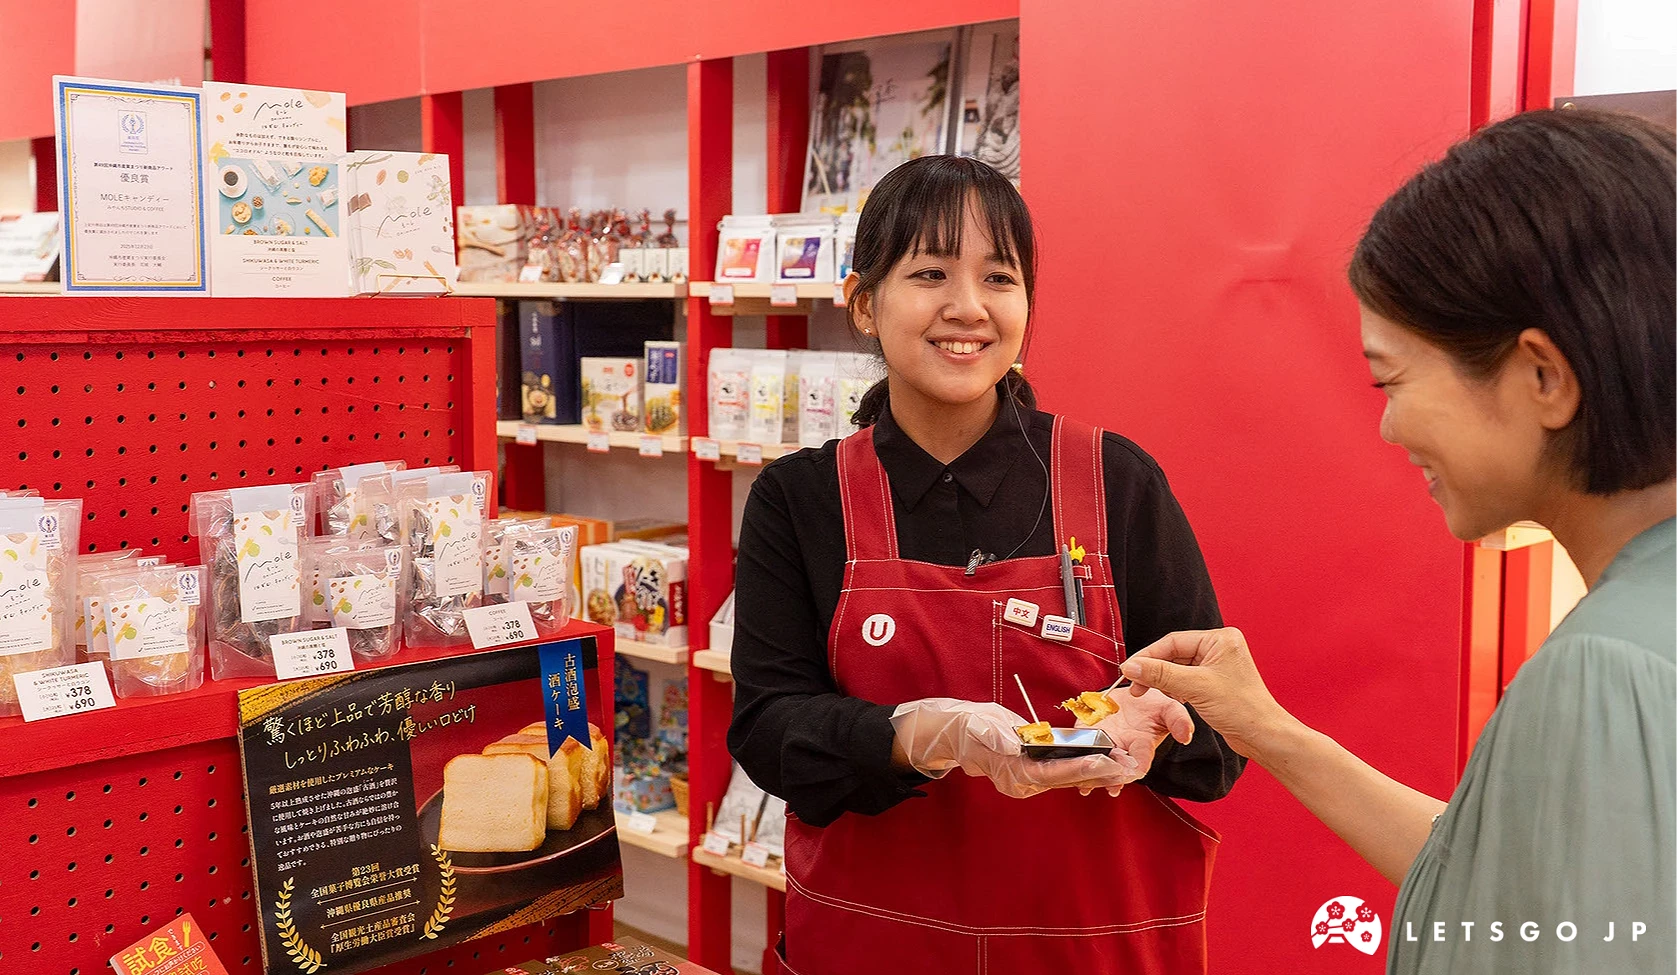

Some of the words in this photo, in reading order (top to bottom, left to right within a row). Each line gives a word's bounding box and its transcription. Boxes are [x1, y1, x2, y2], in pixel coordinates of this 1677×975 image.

[120, 172, 150, 184] 優良賞
[1013, 607, 1030, 619] 中文
[502, 619, 521, 630] ¥378
[869, 621, 889, 639] U
[1046, 624, 1071, 634] ENGLISH
[302, 635, 320, 643] SUGAR
[506, 630, 524, 640] ¥690
[313, 648, 335, 660] ¥378
[315, 660, 338, 671] ¥690
[39, 677, 58, 685] WHITE
[60, 672, 89, 682] TURMERIC
[41, 668, 79, 678] SHIKUWASA
[564, 653, 581, 711] 古酒泡盛
[65, 685, 92, 698] ¥378
[69, 697, 95, 710] ¥690
[548, 672, 564, 730] 酒ケーキ
[263, 680, 457, 746] 驚くほど上品で芳醇な香り
[269, 762, 394, 795] 厳選素材を使用したプレミアムなケーキ
[351, 862, 380, 877] 第23回
[122, 936, 177, 975] 試食
